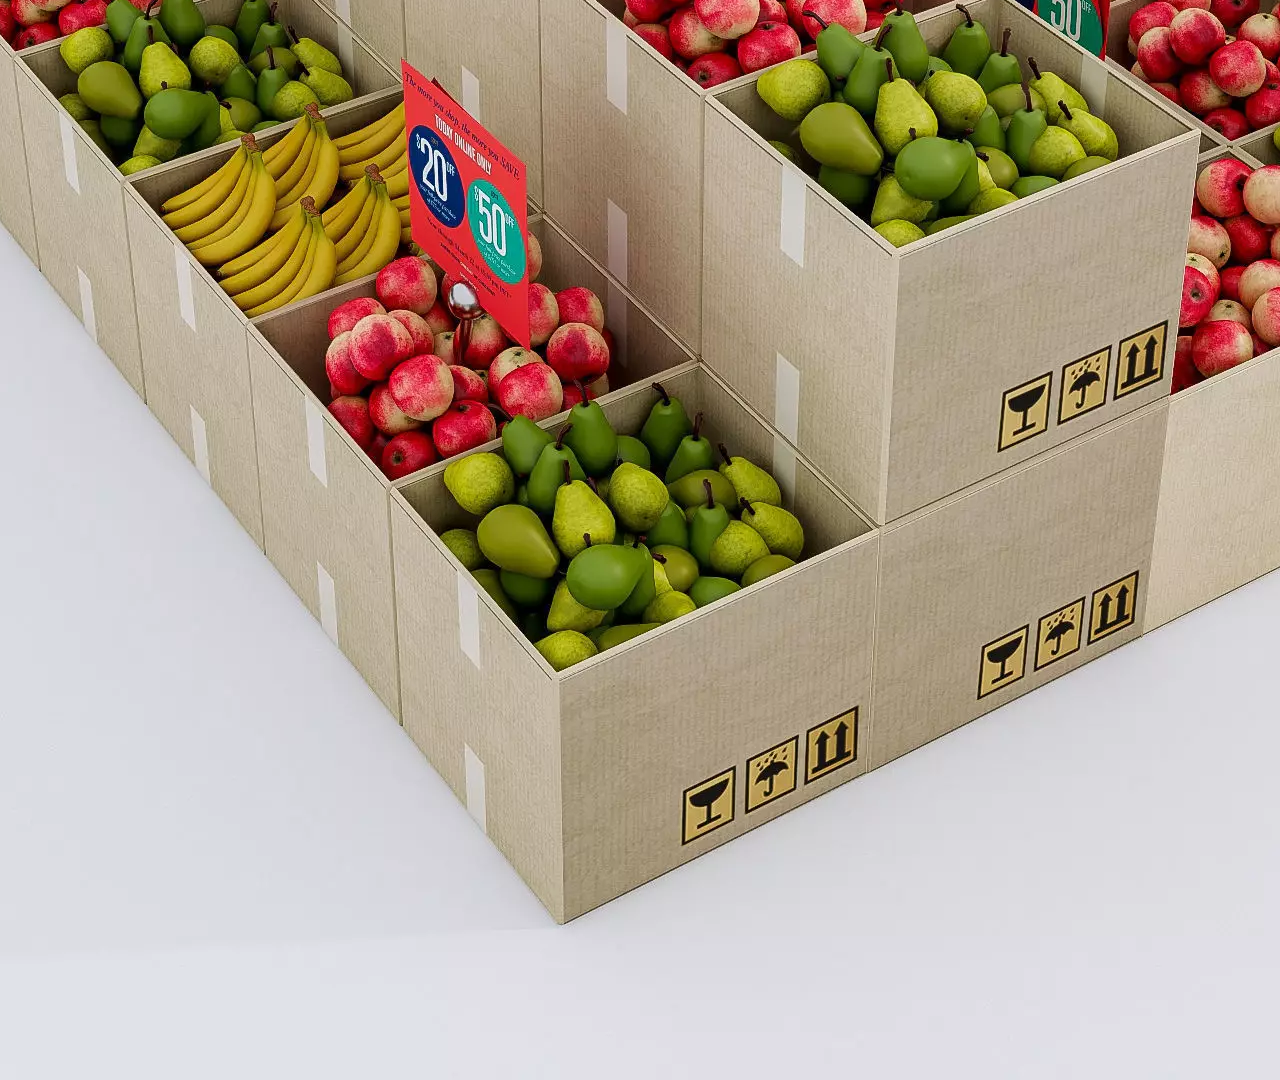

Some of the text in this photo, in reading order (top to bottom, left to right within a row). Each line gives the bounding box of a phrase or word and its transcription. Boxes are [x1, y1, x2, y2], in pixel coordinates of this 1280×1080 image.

[435, 114, 491, 175] TODAY ONLINE ONLY
